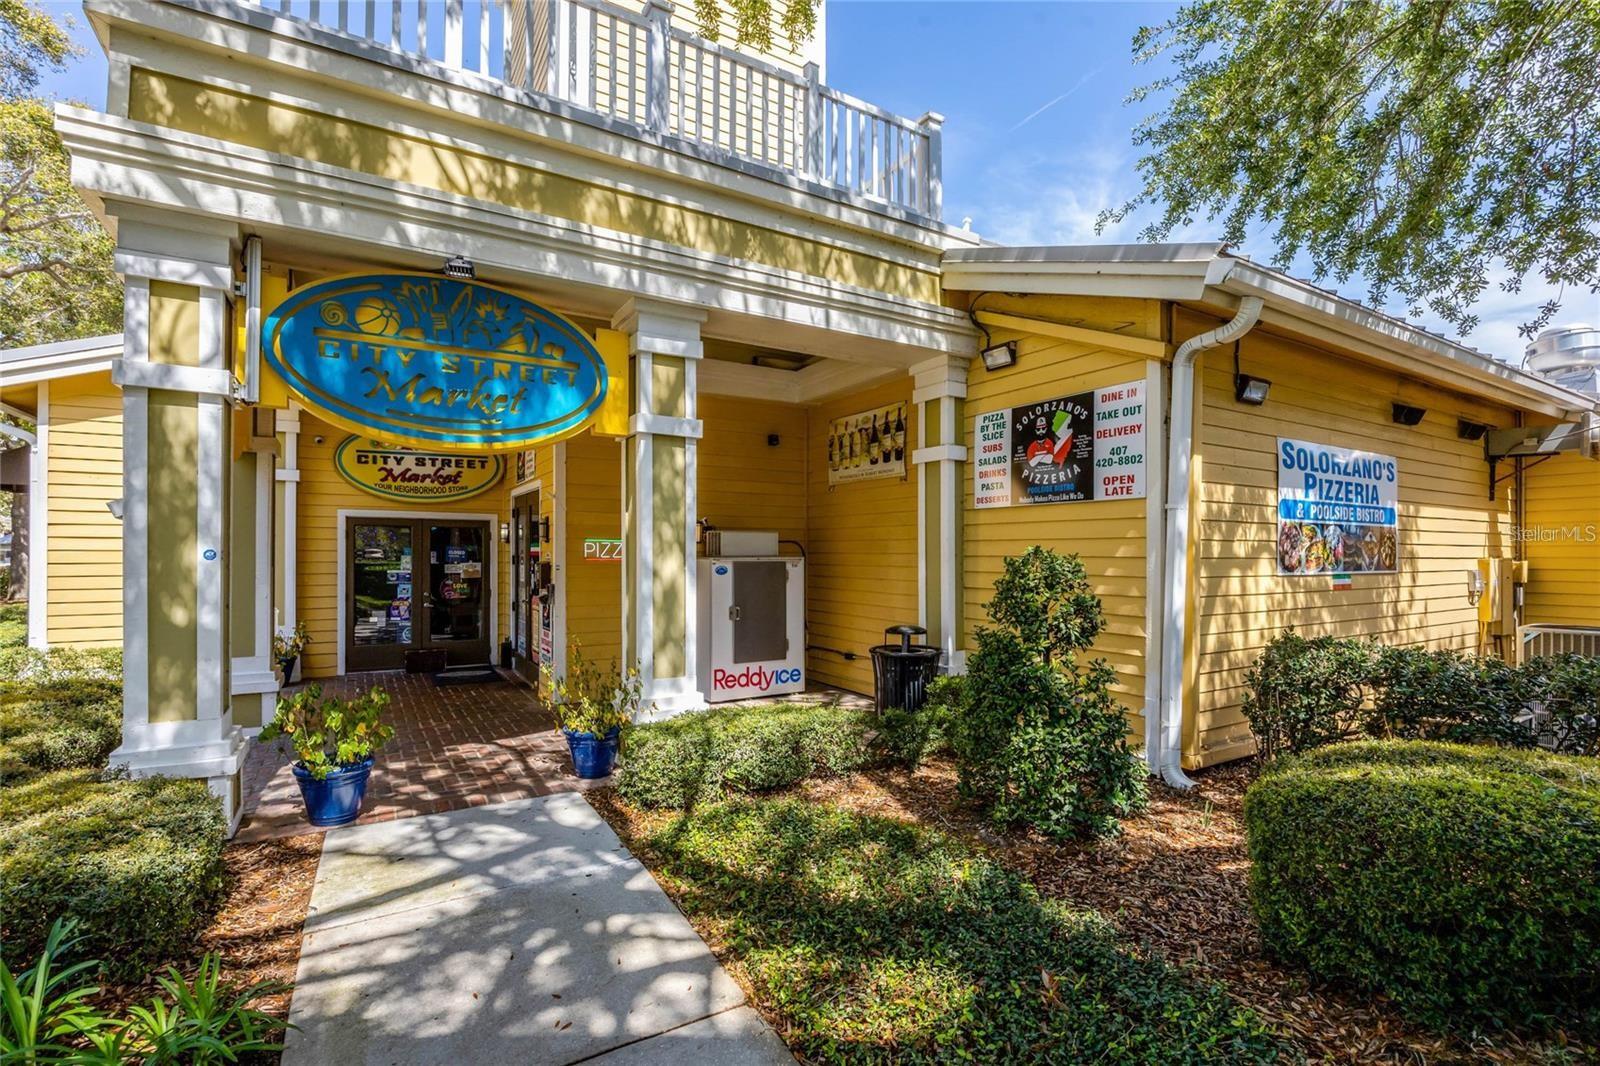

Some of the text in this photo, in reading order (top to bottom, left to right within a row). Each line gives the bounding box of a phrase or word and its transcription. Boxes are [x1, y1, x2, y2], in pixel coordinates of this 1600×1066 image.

[318, 339, 578, 387] CITY STREET
[361, 366, 528, 416] Market
[1101, 388, 1137, 403] DINE IN
[983, 412, 1005, 424] PIZZA
[1016, 401, 1088, 431] SOLORZANO'S
[1096, 405, 1142, 421] TAKE OUT
[980, 421, 1007, 433] BY THE
[1096, 424, 1142, 440] DELIVERY
[982, 430, 1004, 442] SLICE
[982, 443, 1003, 454] SUBS
[1109, 445, 1128, 456] 407
[356, 454, 489, 470] CITY STREET
[978, 455, 1007, 467] SALADS
[1095, 453, 1143, 468] 420-8802
[1281, 441, 1395, 482] SOLORZANO'S
[377, 466, 463, 486] Market
[978, 468, 1007, 479] DRINKS
[1021, 464, 1081, 485] PIZZERIA
[1103, 474, 1135, 486] OPEN
[374, 483, 469, 495] YOUR NEIGHBORHOOD STORE
[981, 481, 1004, 491] PASTA
[1105, 485, 1133, 497] LATE
[1304, 472, 1380, 505] PIZZERIA
[976, 494, 1009, 505] DESSERTS
[1048, 493, 1060, 502] Pizza
[1296, 503, 1385, 523] & POOLSIDE BISTRO
